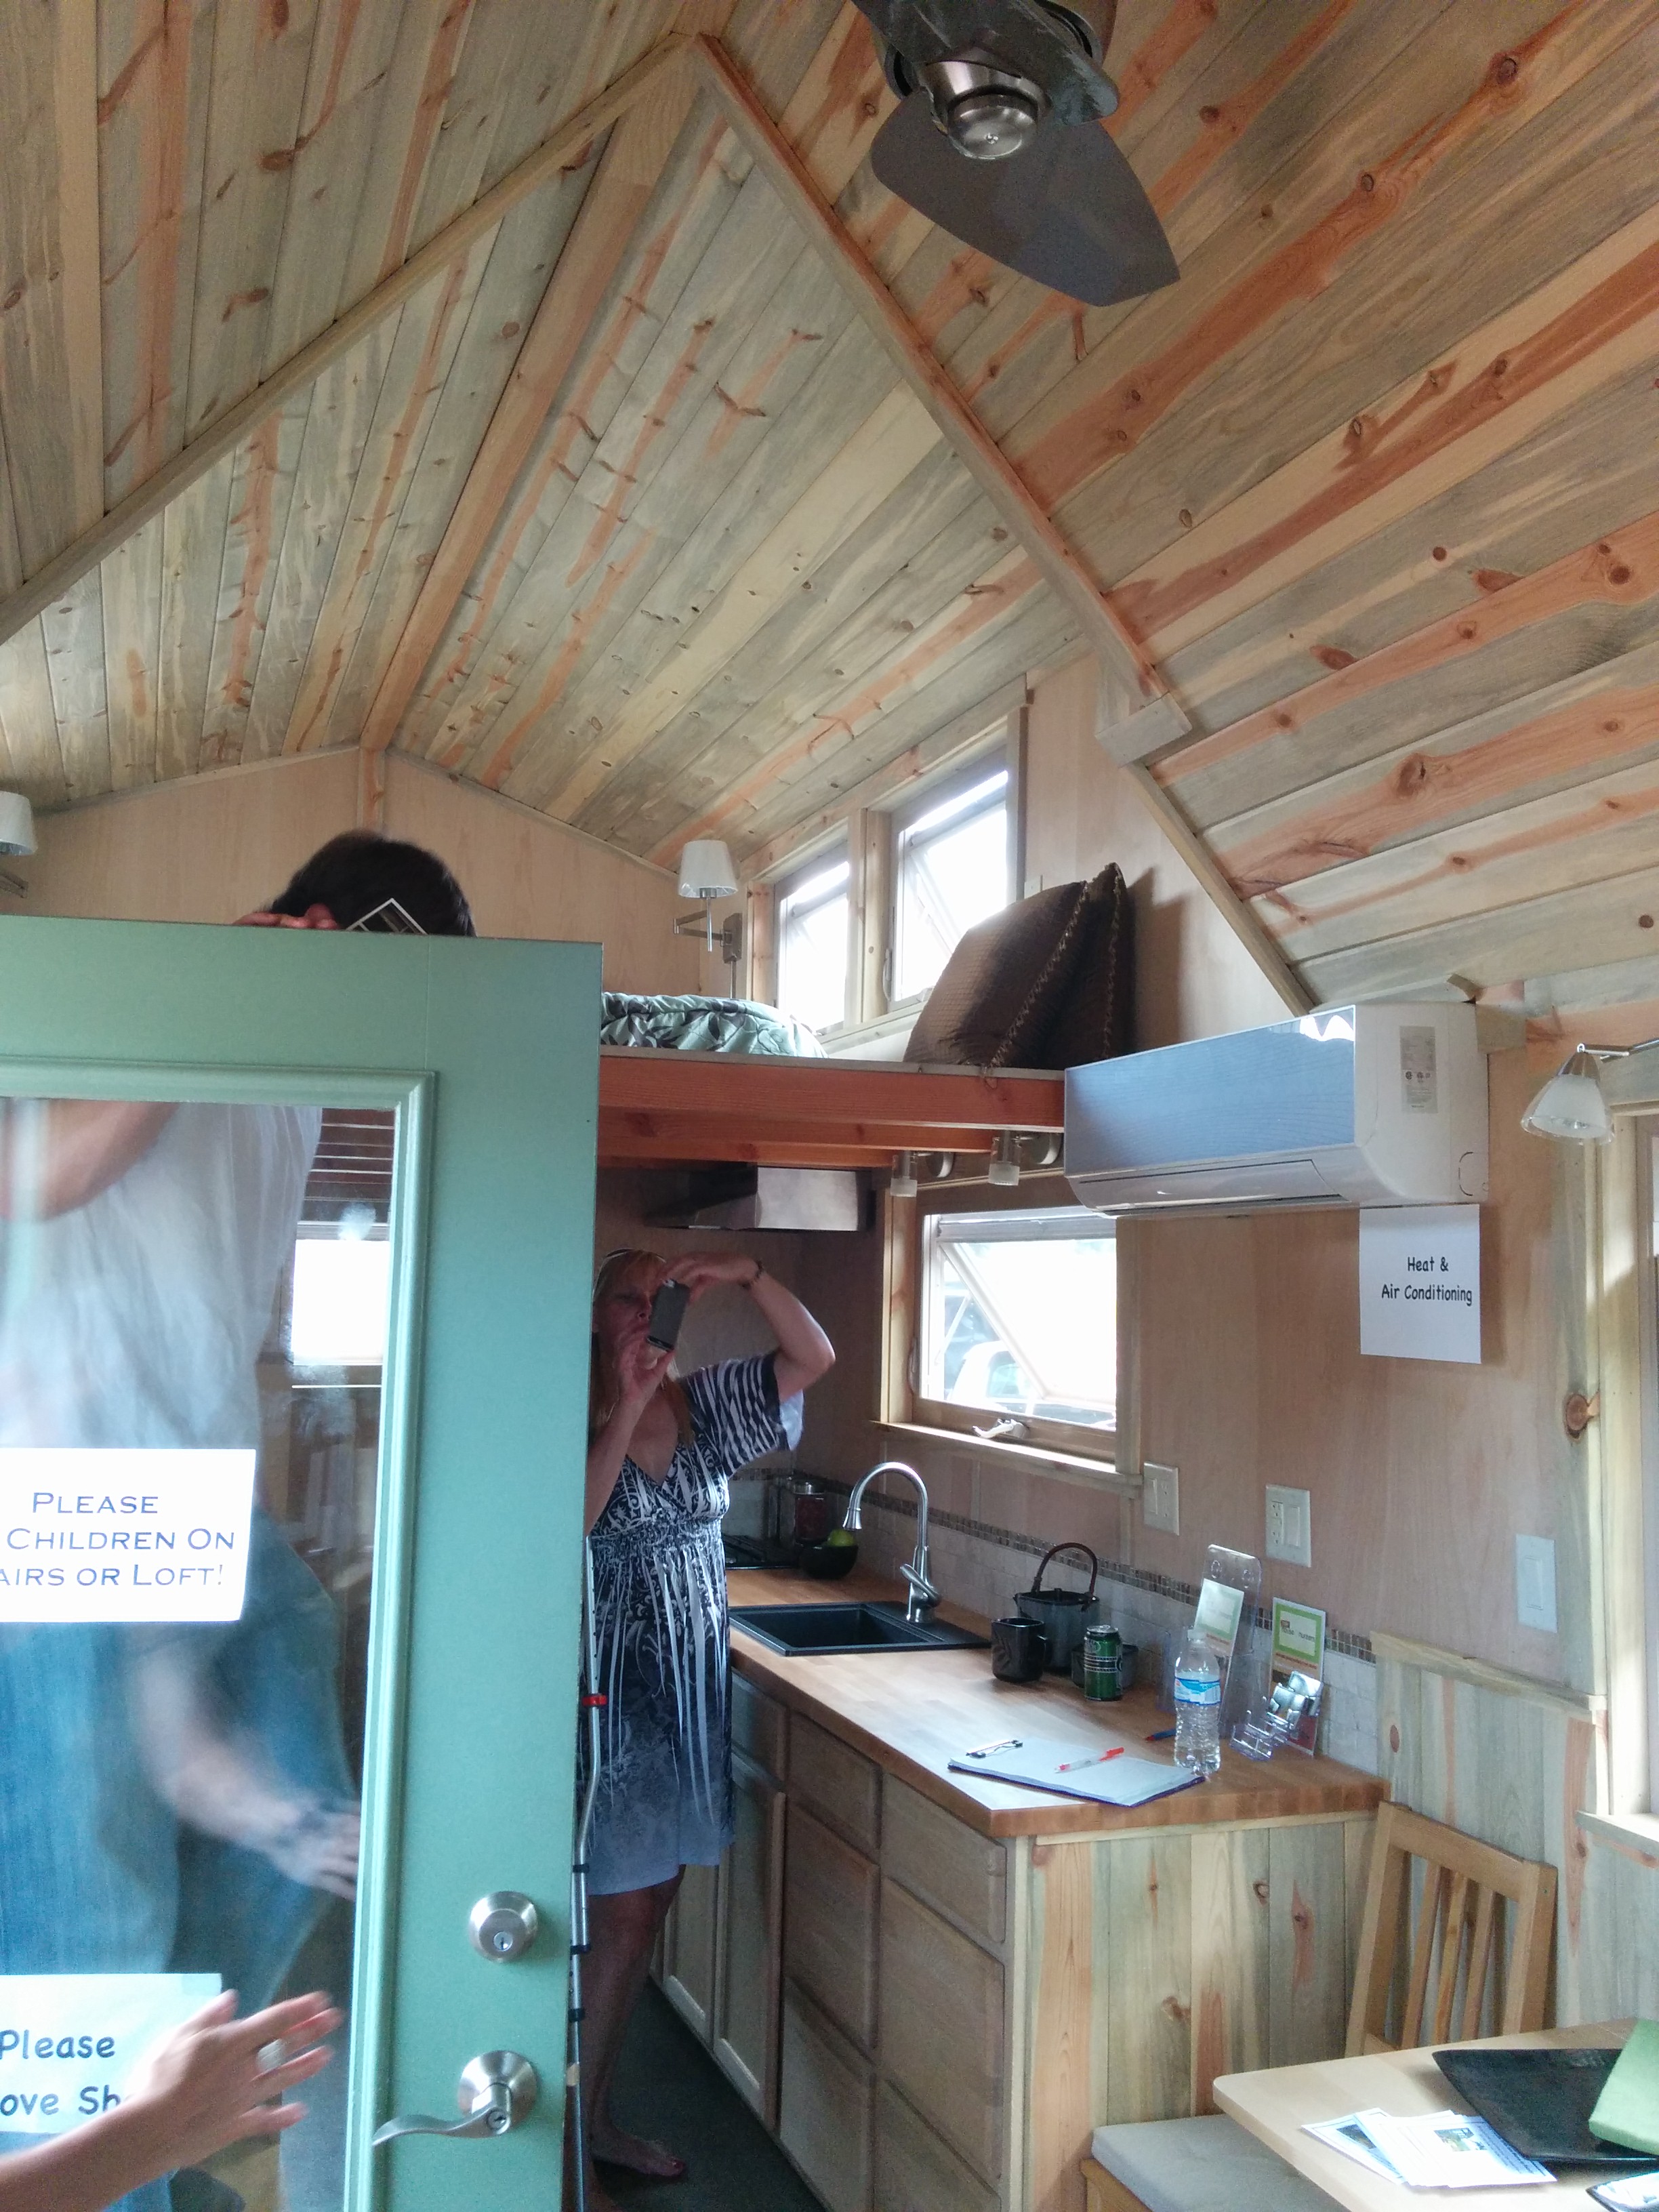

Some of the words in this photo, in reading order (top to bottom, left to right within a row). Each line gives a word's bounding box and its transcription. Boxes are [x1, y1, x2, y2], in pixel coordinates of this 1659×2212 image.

[1408, 1256, 1435, 1272] Heat
[1439, 1256, 1449, 1272] &
[1381, 1283, 1399, 1299] Air
[1404, 1284, 1472, 1307] Conditioning
[0, 2029, 115, 2060] Please
[79, 2085, 125, 2115] Sh
